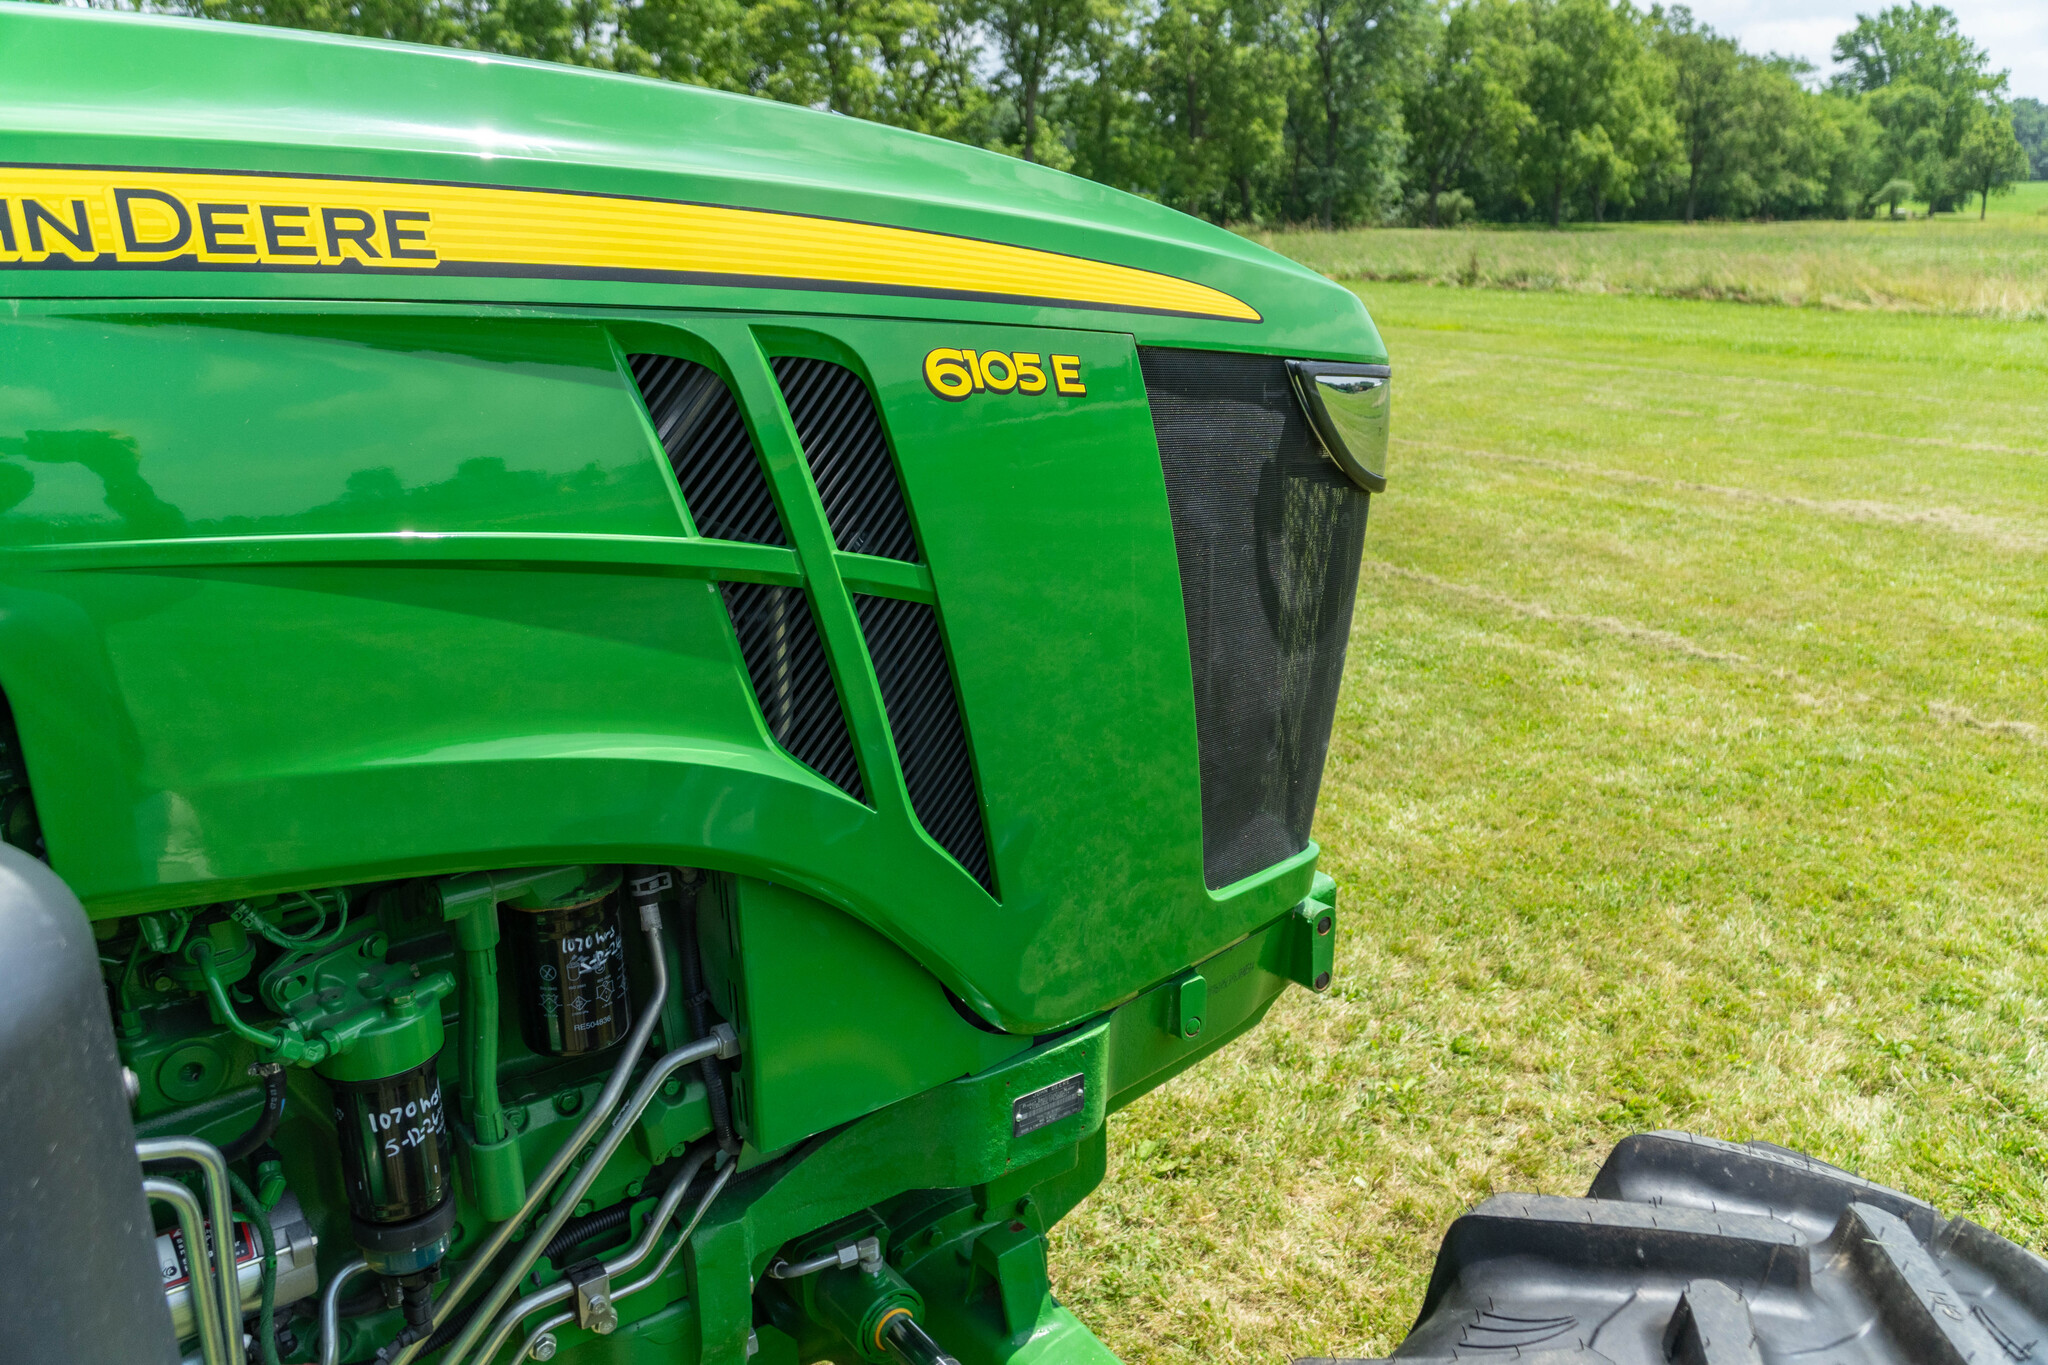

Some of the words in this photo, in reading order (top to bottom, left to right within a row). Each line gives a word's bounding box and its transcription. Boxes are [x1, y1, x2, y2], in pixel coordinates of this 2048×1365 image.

[112, 186, 440, 262] DEERE
[922, 347, 1048, 403] 6105
[1049, 354, 1088, 399] E
[562, 935, 593, 954] 1070
[573, 1015, 612, 1032] RE504836
[368, 1102, 418, 1134] 1070
